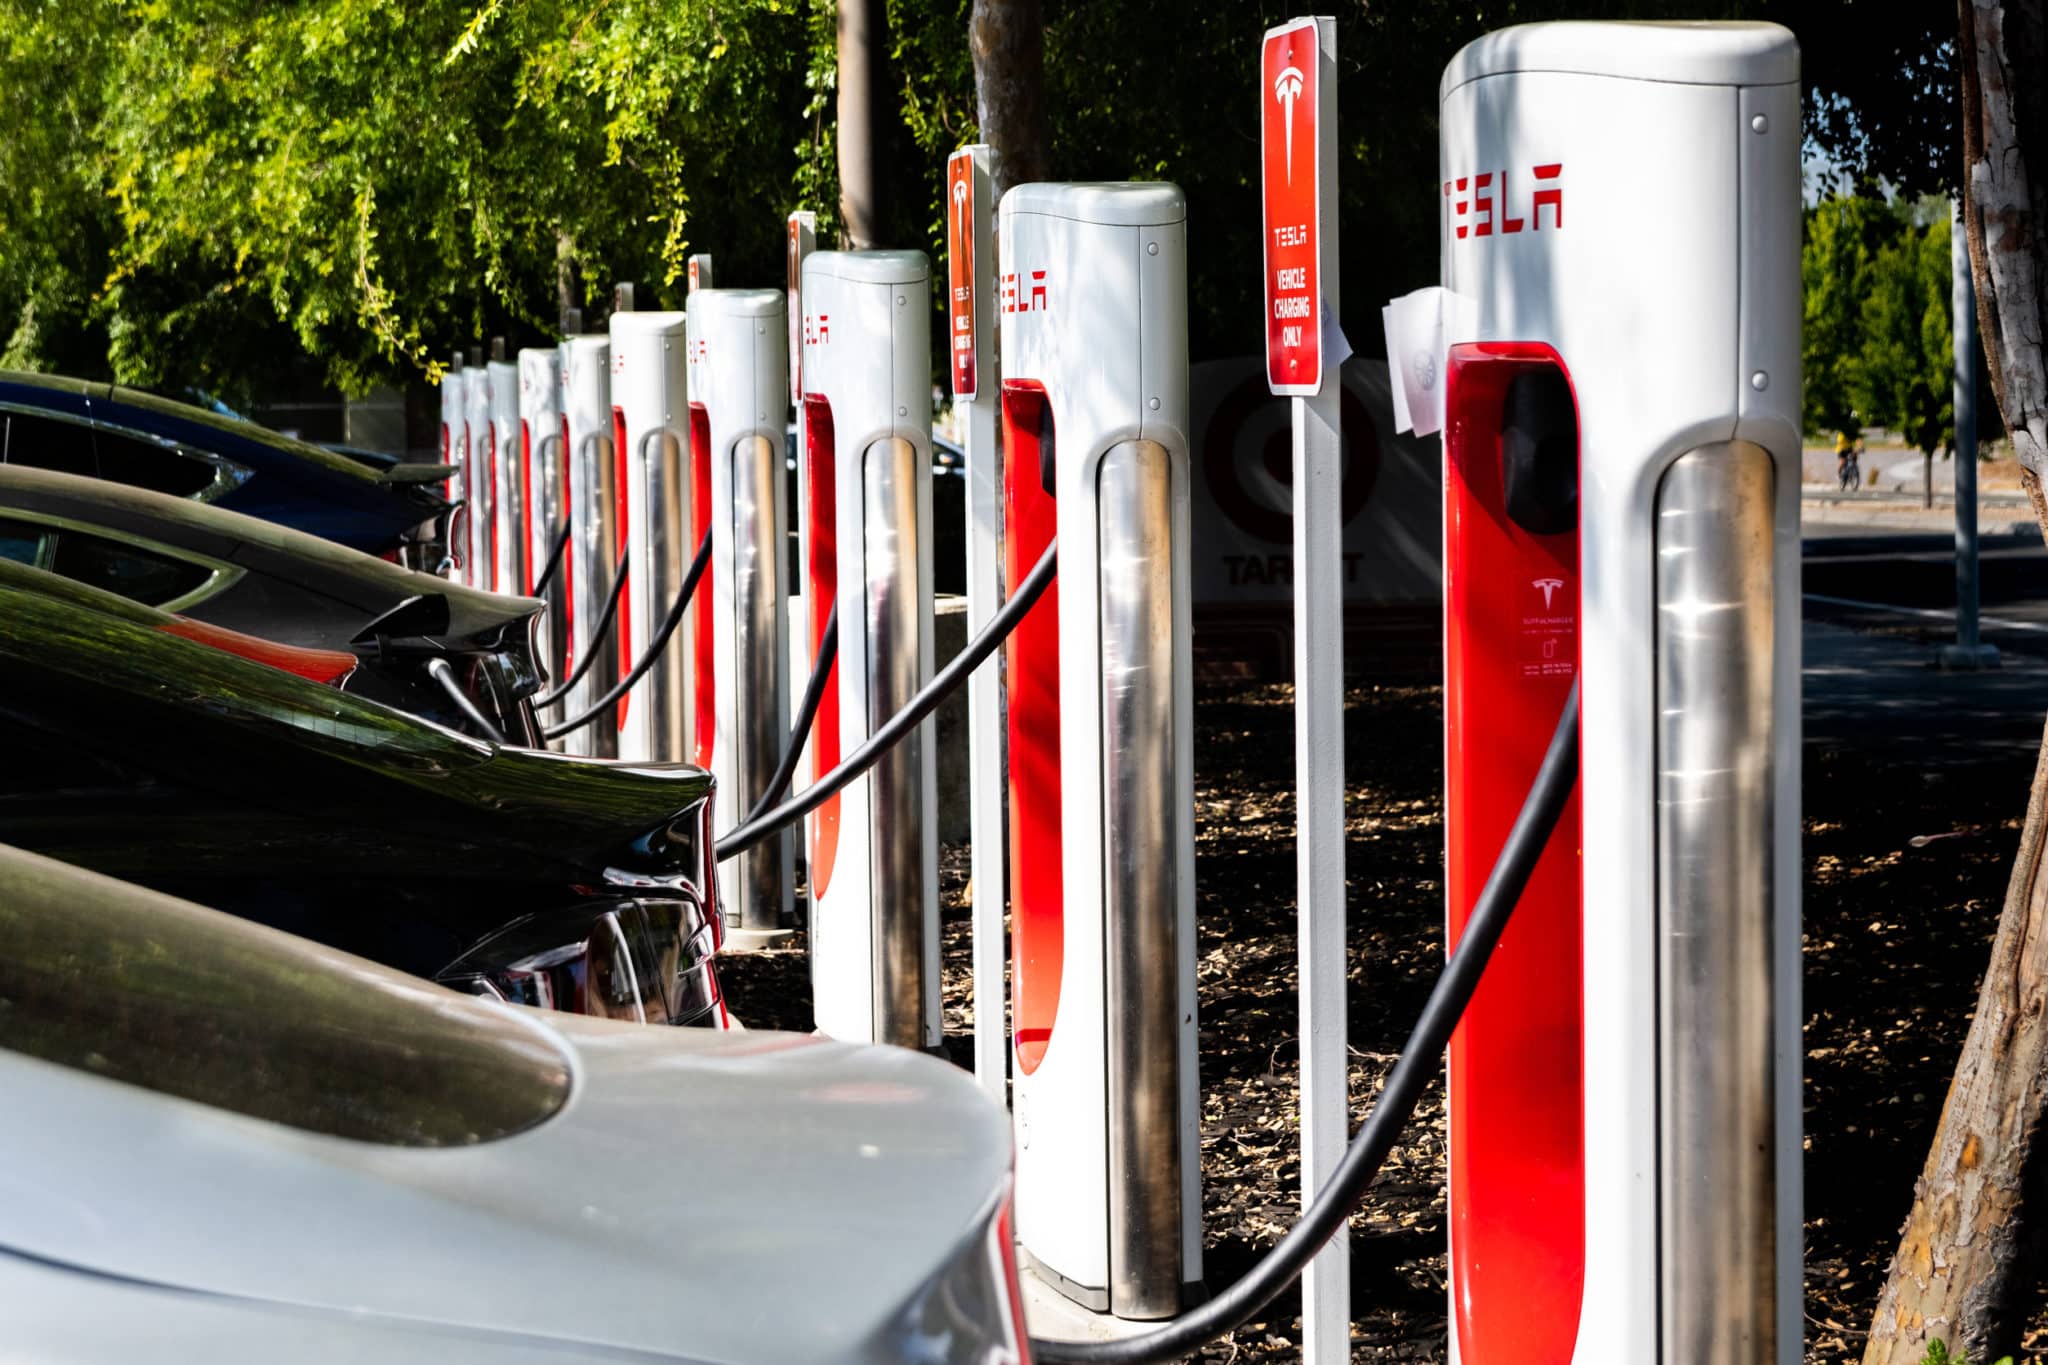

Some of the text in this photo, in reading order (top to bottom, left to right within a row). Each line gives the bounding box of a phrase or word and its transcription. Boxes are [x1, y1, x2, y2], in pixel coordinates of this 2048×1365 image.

[1274, 224, 1307, 248] TESLA
[1277, 267, 1306, 290] VEHICLE
[1001, 270, 1047, 314] ESLA
[1274, 296, 1310, 319] CHARGING
[1283, 326, 1303, 347] ONLY
[1221, 552, 1364, 586] TART
